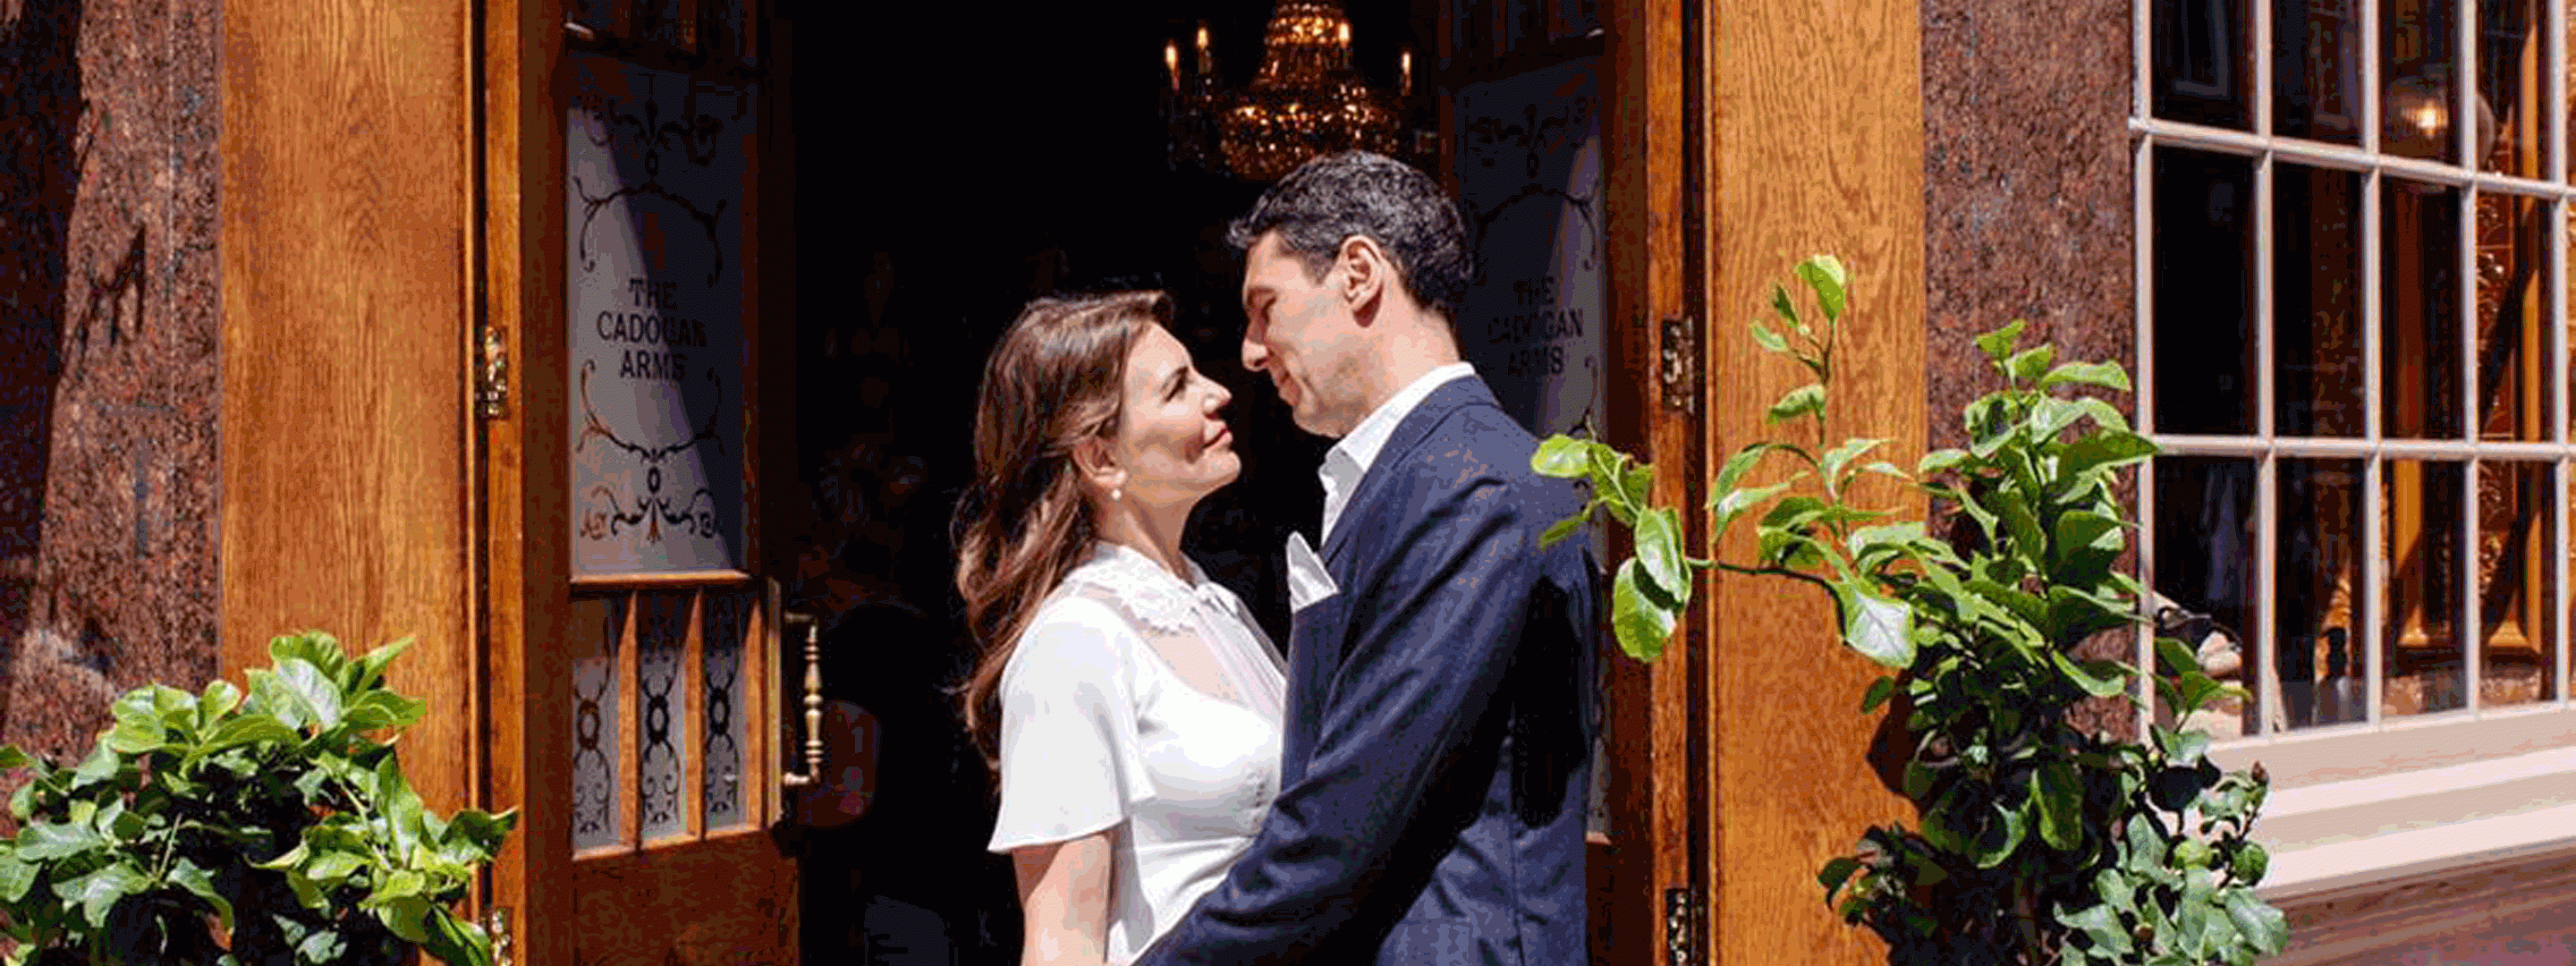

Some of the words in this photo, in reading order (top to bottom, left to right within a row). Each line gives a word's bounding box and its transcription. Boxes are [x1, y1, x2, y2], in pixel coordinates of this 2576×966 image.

[628, 277, 678, 310] THE
[1513, 277, 1555, 307] THE
[597, 310, 707, 347] CADOGAN
[619, 349, 688, 382] ARMS
